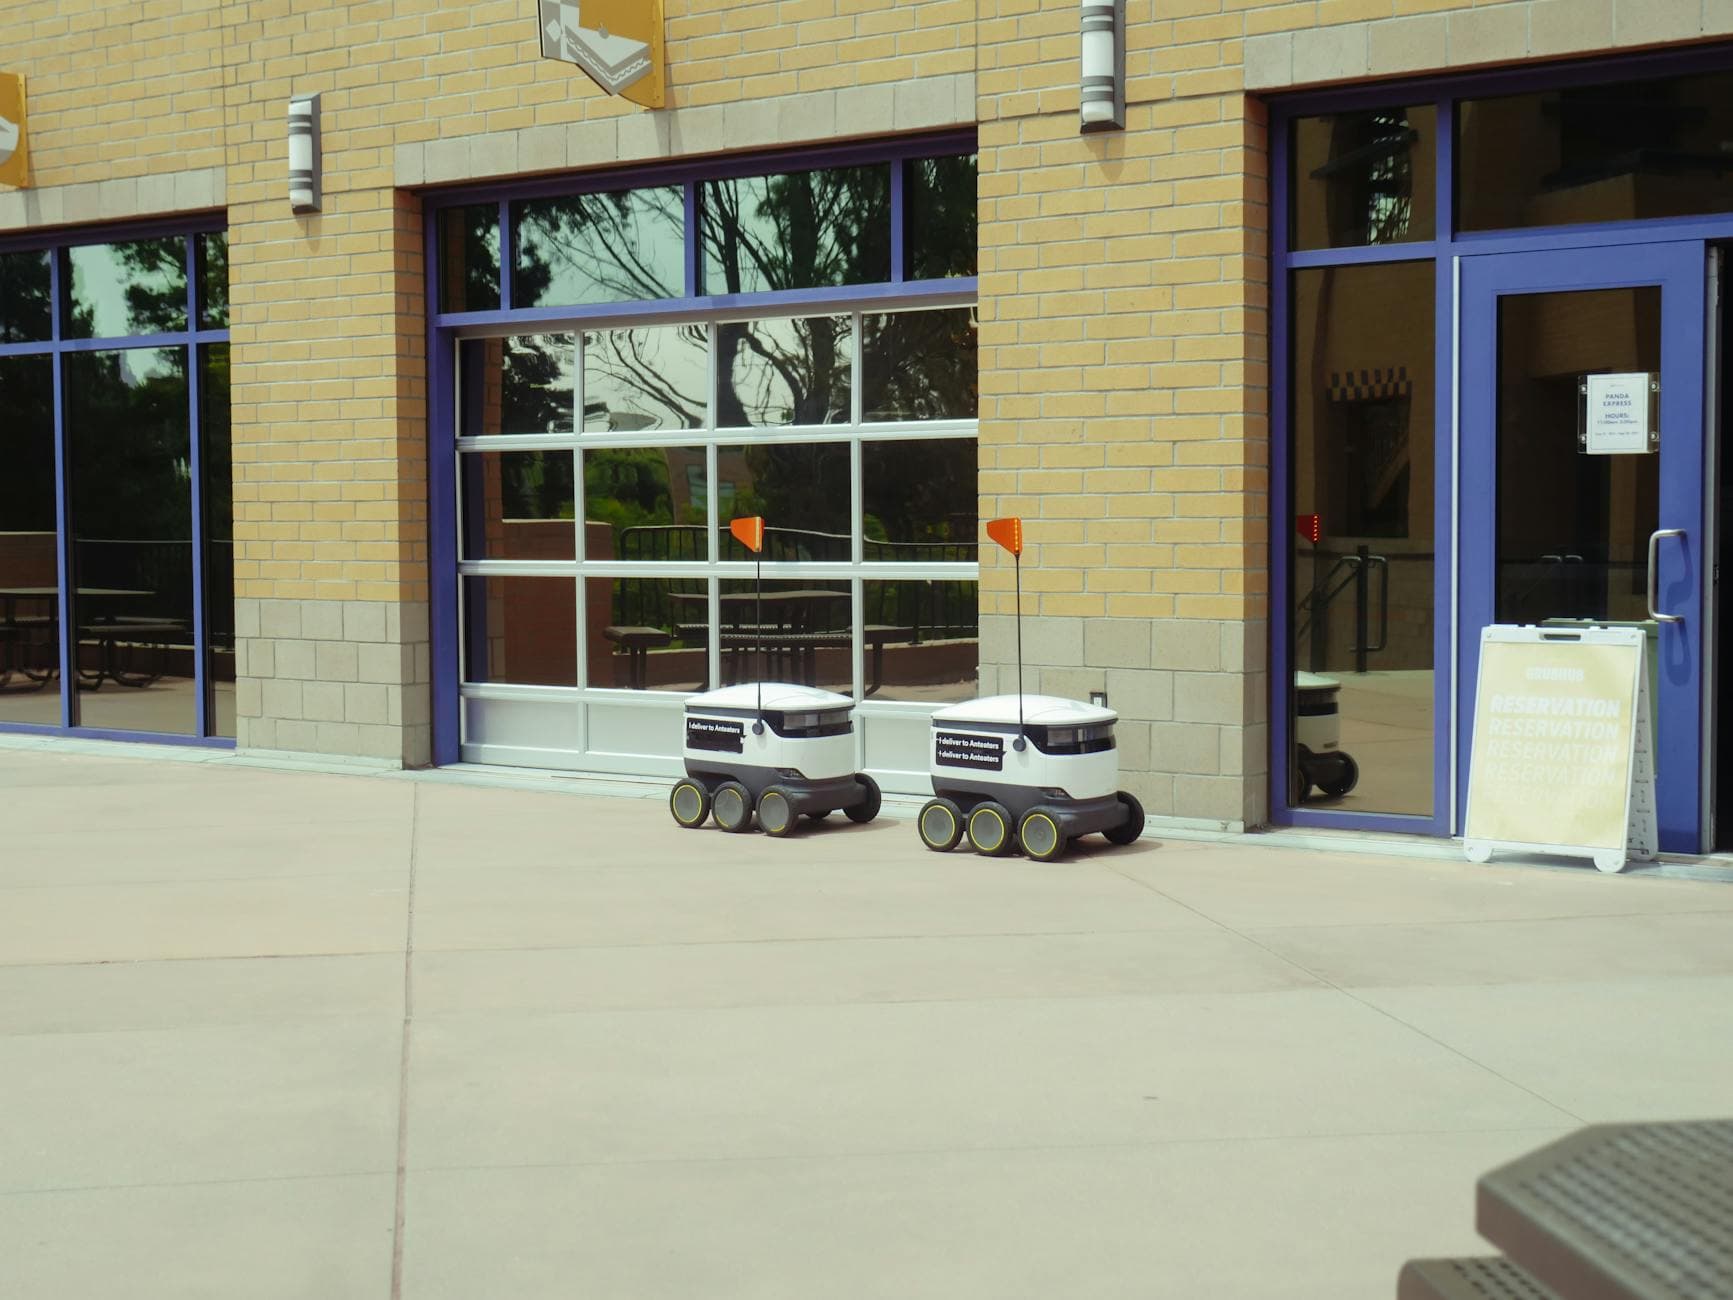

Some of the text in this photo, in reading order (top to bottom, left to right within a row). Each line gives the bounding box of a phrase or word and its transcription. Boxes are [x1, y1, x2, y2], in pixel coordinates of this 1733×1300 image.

[1489, 694, 1621, 718] RESERVATION
[692, 722, 708, 730] deliver
[715, 724, 740, 734] Anteaters
[1487, 717, 1619, 740] RESERVATION
[942, 737, 961, 746] deliver
[962, 739, 969, 747] to
[970, 739, 999, 749] Anteaters
[1486, 739, 1618, 763] RESERVATION
[942, 750, 961, 759] deliver
[962, 752, 969, 760] to
[970, 753, 999, 763] Anteaters
[1484, 761, 1616, 785] RESERVATION
